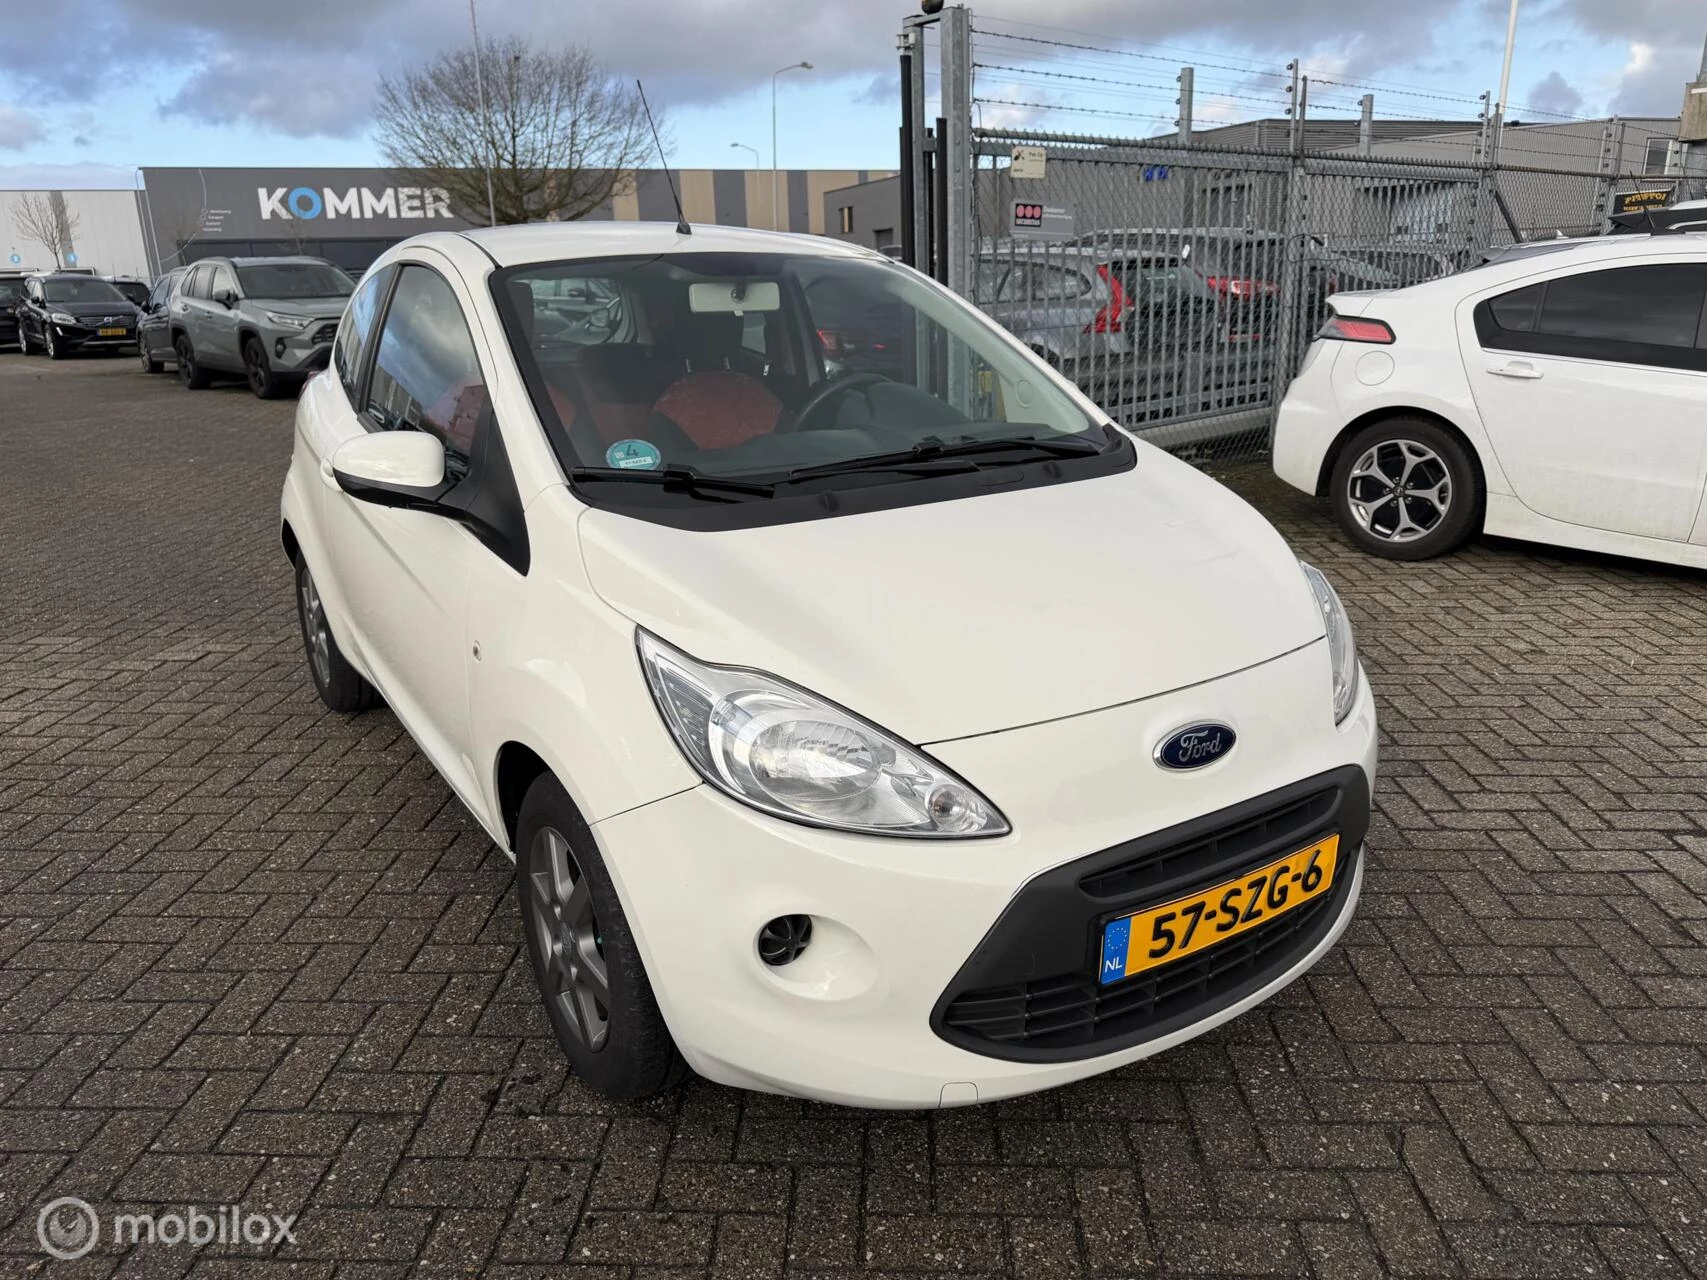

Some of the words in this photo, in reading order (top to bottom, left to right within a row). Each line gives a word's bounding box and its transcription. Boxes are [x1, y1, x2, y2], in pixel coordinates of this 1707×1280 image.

[257, 187, 454, 220] KOMMER
[1178, 729, 1222, 762] Ford
[1148, 849, 1323, 959] 57-SZG-6
[1105, 956, 1123, 973] NL
